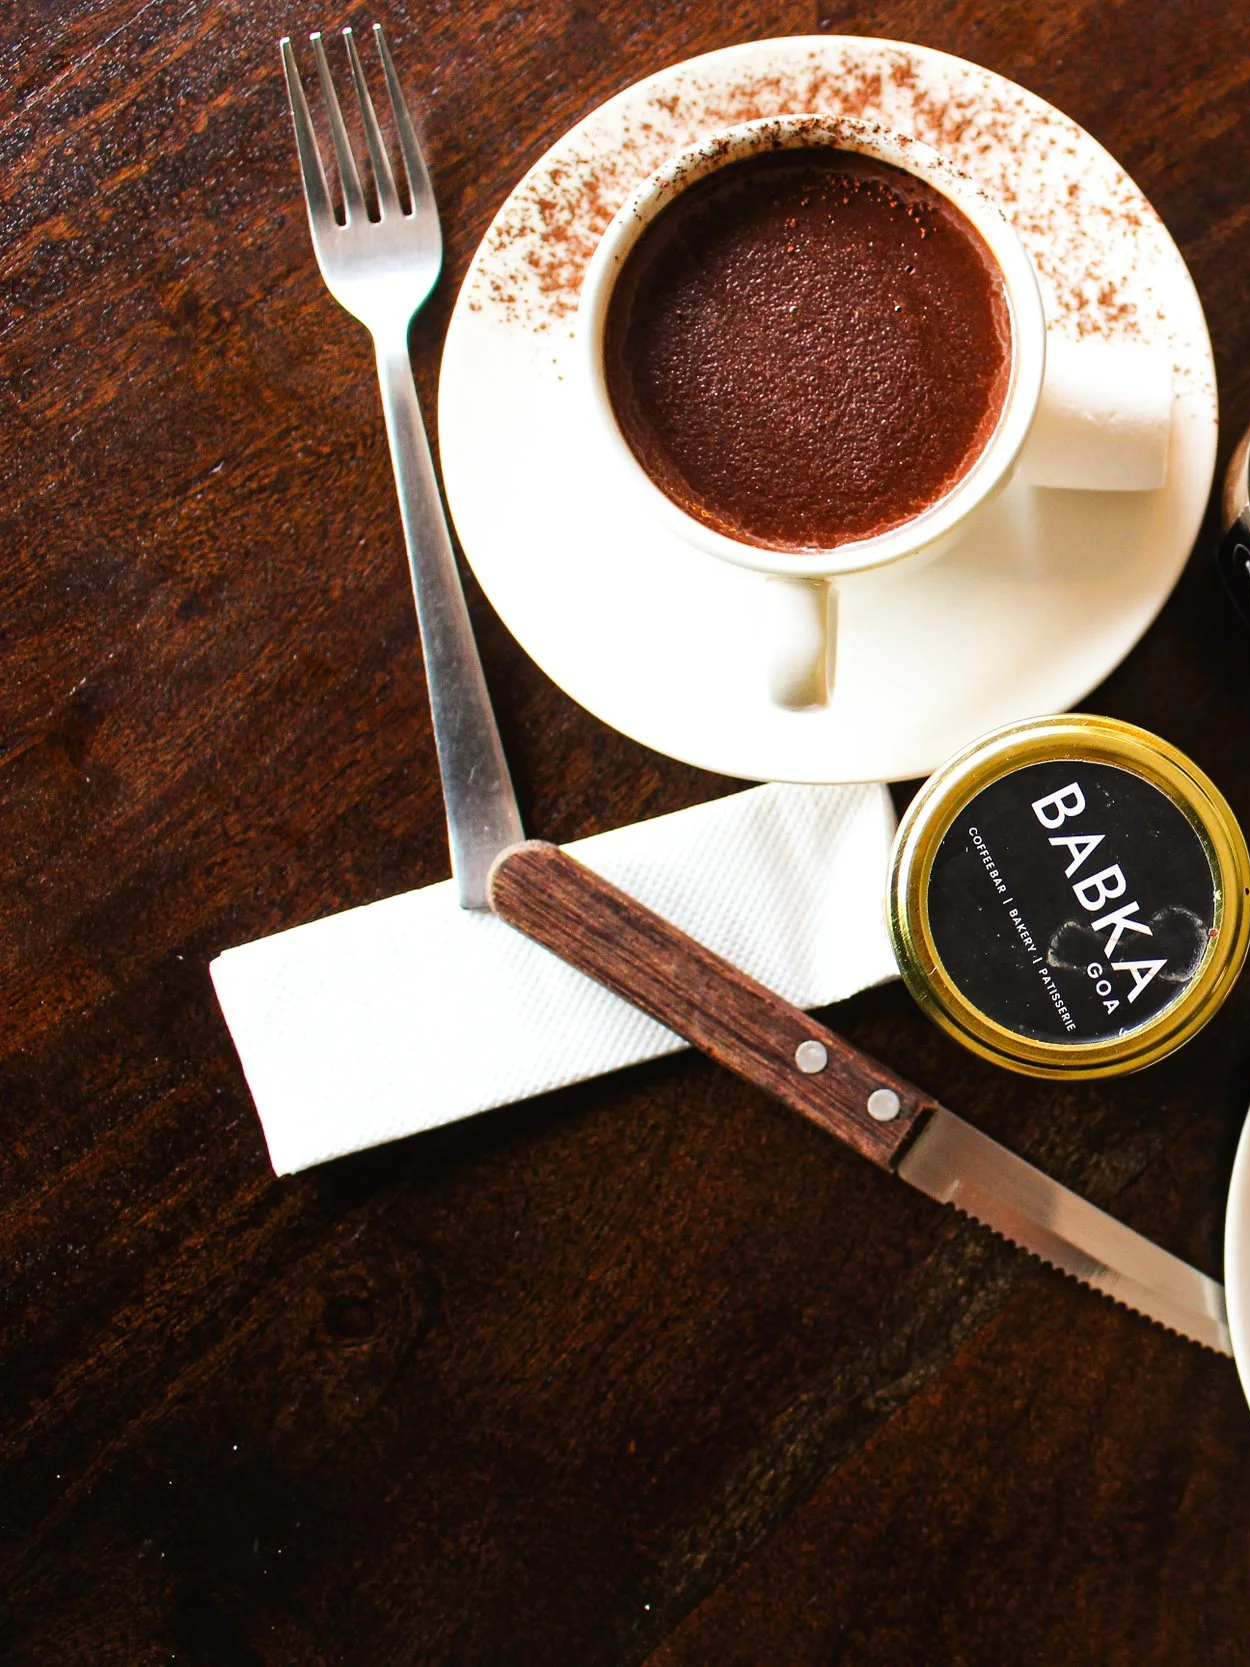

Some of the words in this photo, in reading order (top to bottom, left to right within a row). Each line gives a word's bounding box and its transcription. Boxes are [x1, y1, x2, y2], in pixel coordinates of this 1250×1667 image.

[968, 827, 1007, 894] COFFEEBAR
[1009, 908, 1037, 953] BAKERY
[1038, 967, 1076, 1032] PATISSERIE
[1031, 781, 1168, 1004] BABKA
[1086, 962, 1120, 1015] GOA
